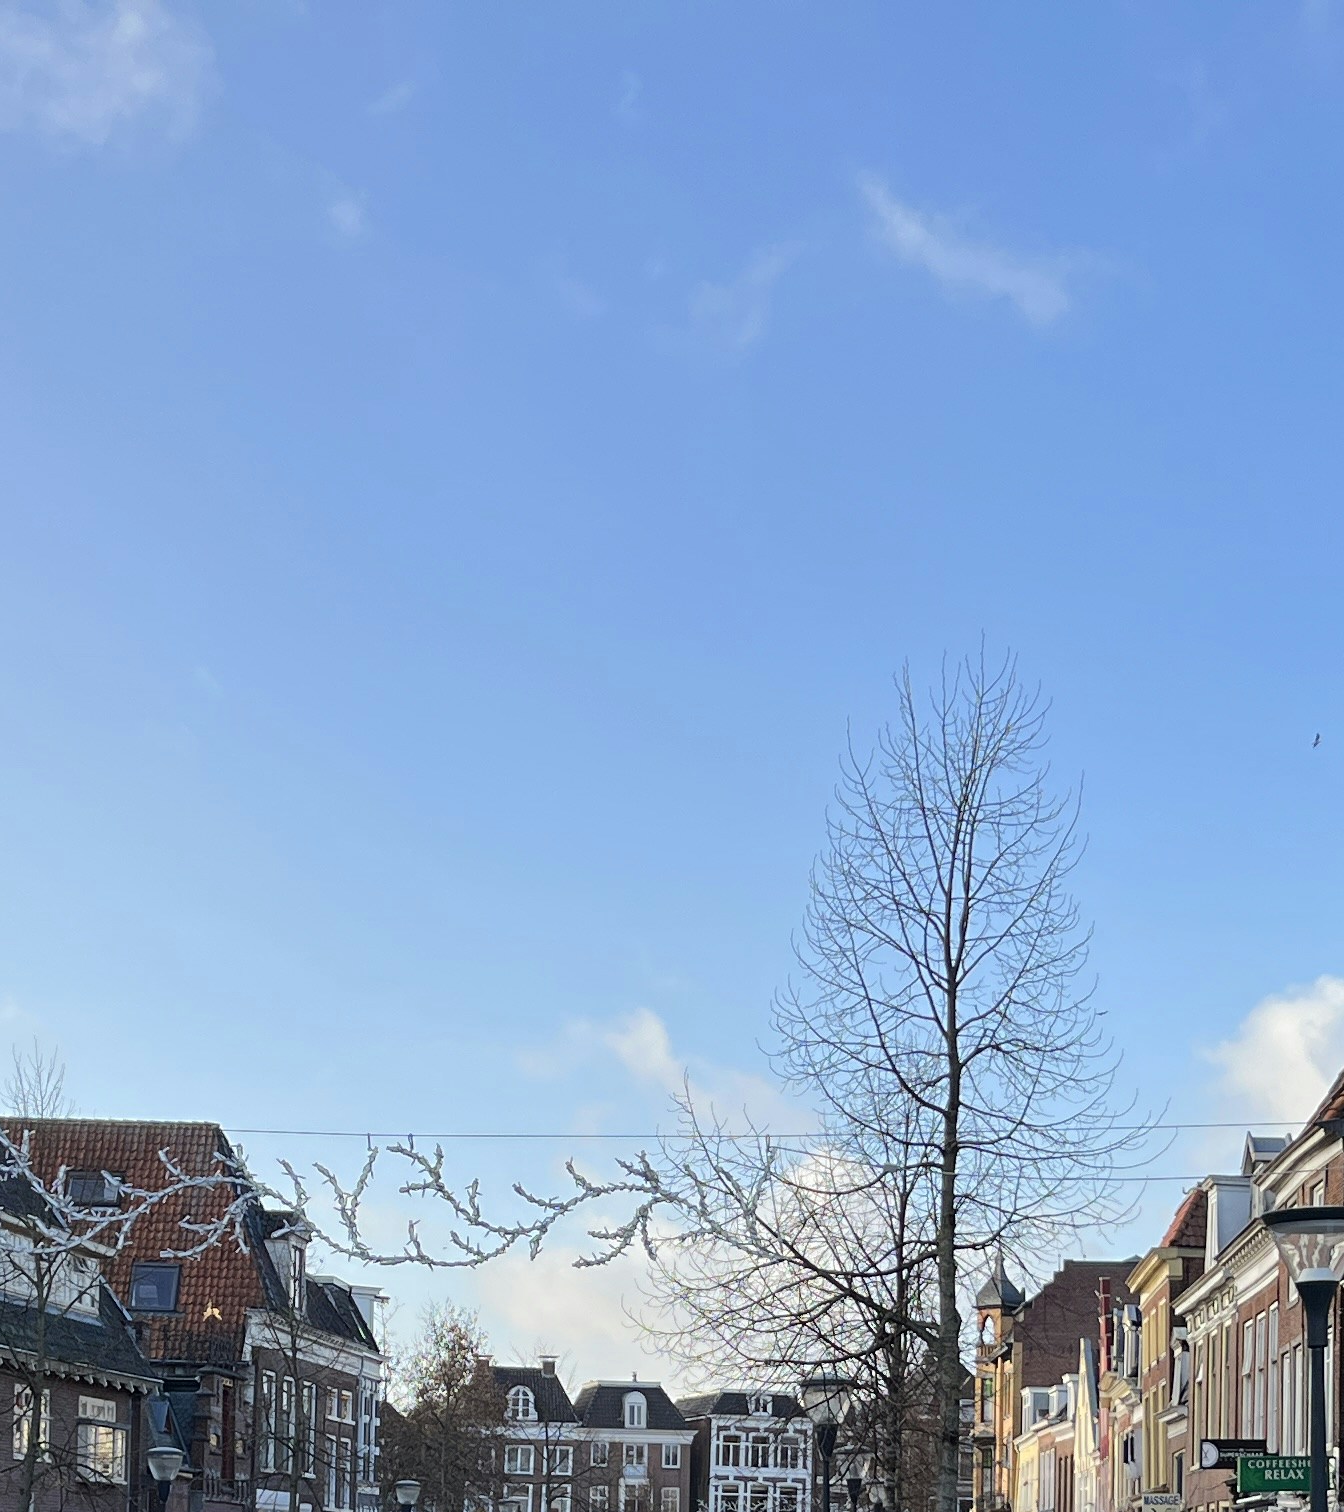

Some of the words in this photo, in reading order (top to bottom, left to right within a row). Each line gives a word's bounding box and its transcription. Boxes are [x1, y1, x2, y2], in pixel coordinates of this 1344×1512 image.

[1247, 1459, 1312, 1469] COFFEESH
[1264, 1469, 1305, 1480] RELAX
[1143, 1495, 1180, 1506] MASSAGE
